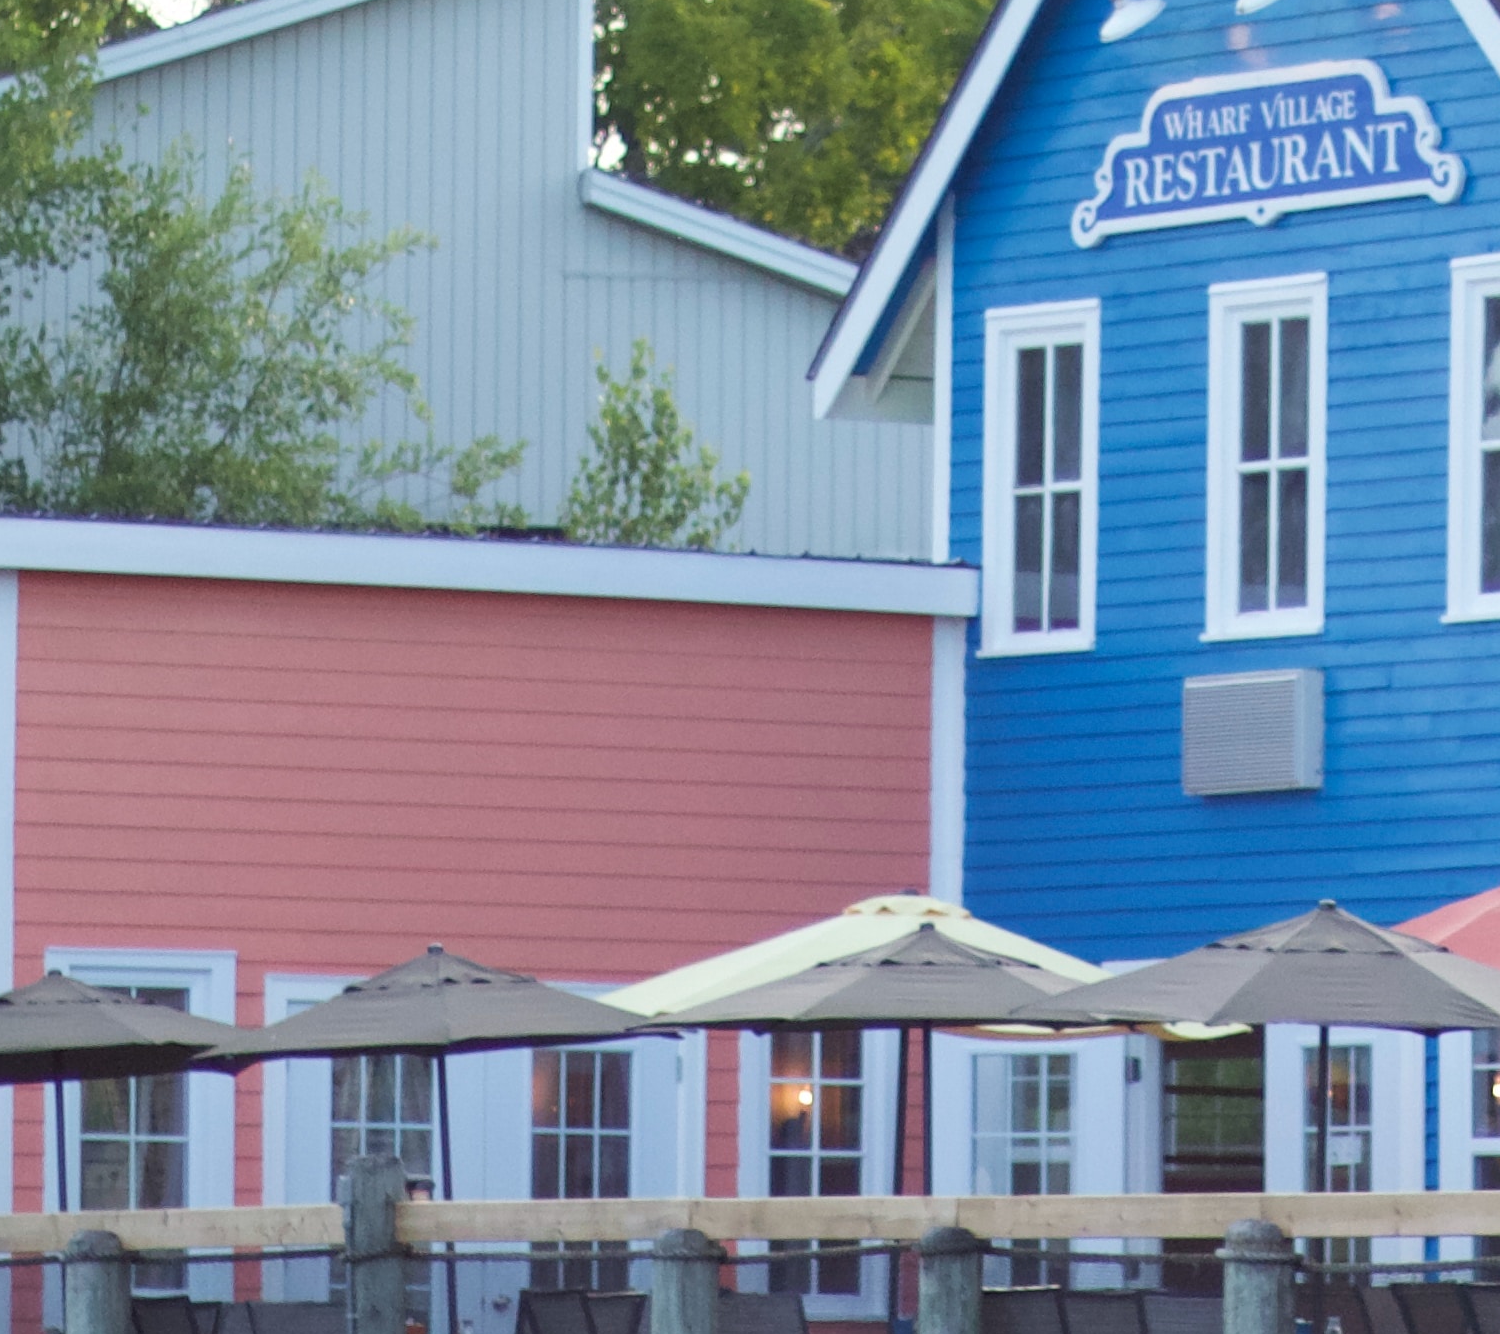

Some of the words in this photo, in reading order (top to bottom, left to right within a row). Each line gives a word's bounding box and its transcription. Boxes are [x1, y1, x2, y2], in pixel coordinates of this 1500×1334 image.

[1164, 104, 1250, 140] WHARF
[1261, 90, 1356, 129] VILLAGE
[1124, 122, 1407, 207] RESTAURANT
